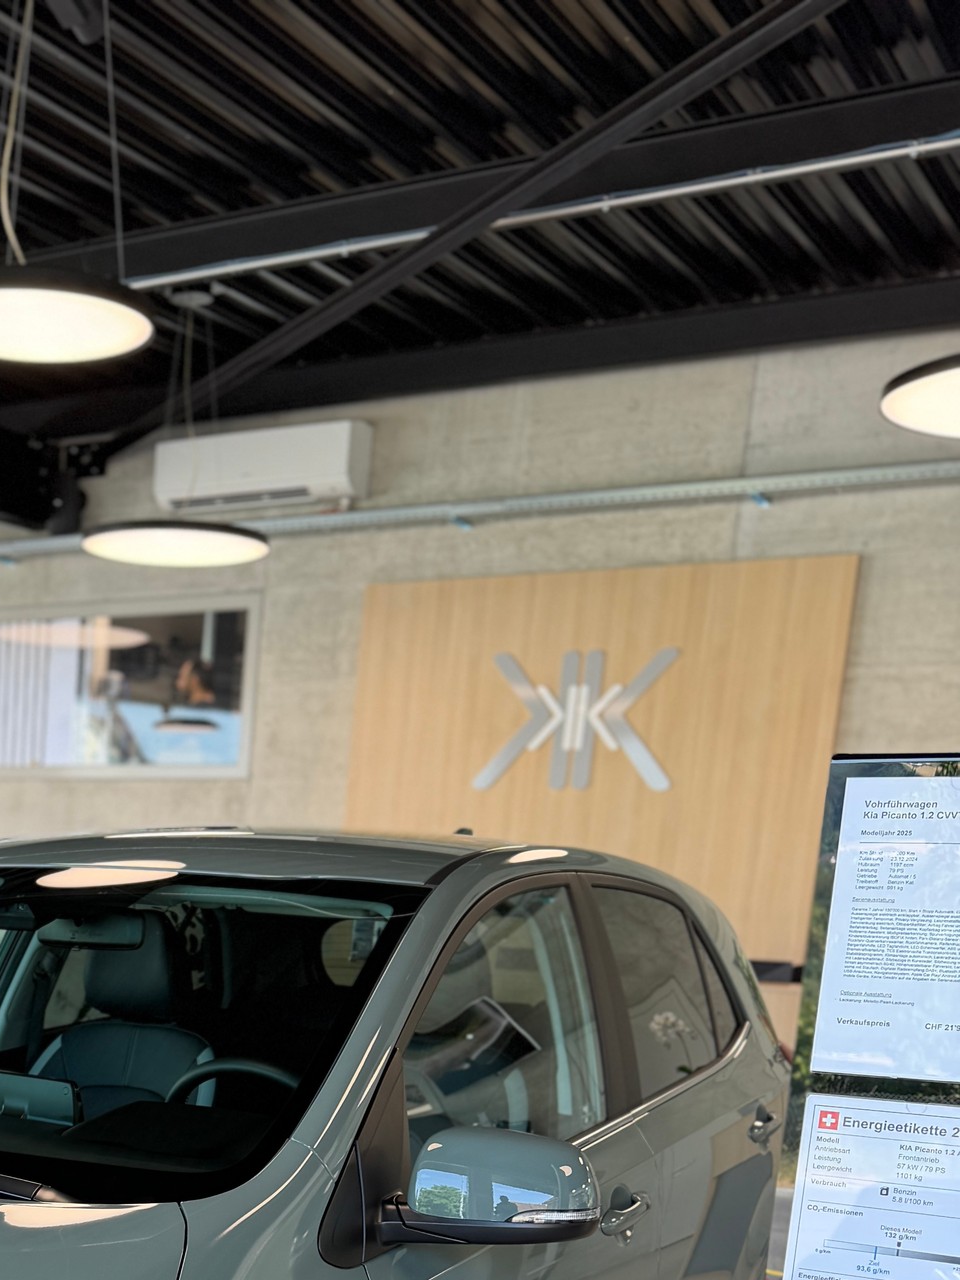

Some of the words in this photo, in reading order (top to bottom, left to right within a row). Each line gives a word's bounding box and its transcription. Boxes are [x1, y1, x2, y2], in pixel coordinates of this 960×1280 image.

[864, 800, 938, 810] Vohrführwagen
[863, 811, 878, 819] Kia
[881, 811, 917, 819] Picanto
[921, 811, 934, 819] 1.2
[936, 811, 960, 819] CVV
[837, 1017, 890, 1027] Verkaufspreis
[843, 1117, 947, 1137] Energieetikette
[815, 1145, 850, 1154] Antriebsart
[900, 1144, 912, 1152] KIA
[915, 1146, 942, 1154] Picanto
[814, 1154, 841, 1163] Leistung
[898, 1154, 939, 1163] Frontantrieb
[813, 1163, 852, 1173] Leergewicht
[811, 1178, 847, 1188] Verbrauch
[893, 1187, 917, 1195] Benzin
[880, 1225, 901, 1233] Dieses
[902, 1227, 922, 1235] Modell
[898, 1233, 916, 1241] g/km
[872, 1267, 890, 1275] g/km
